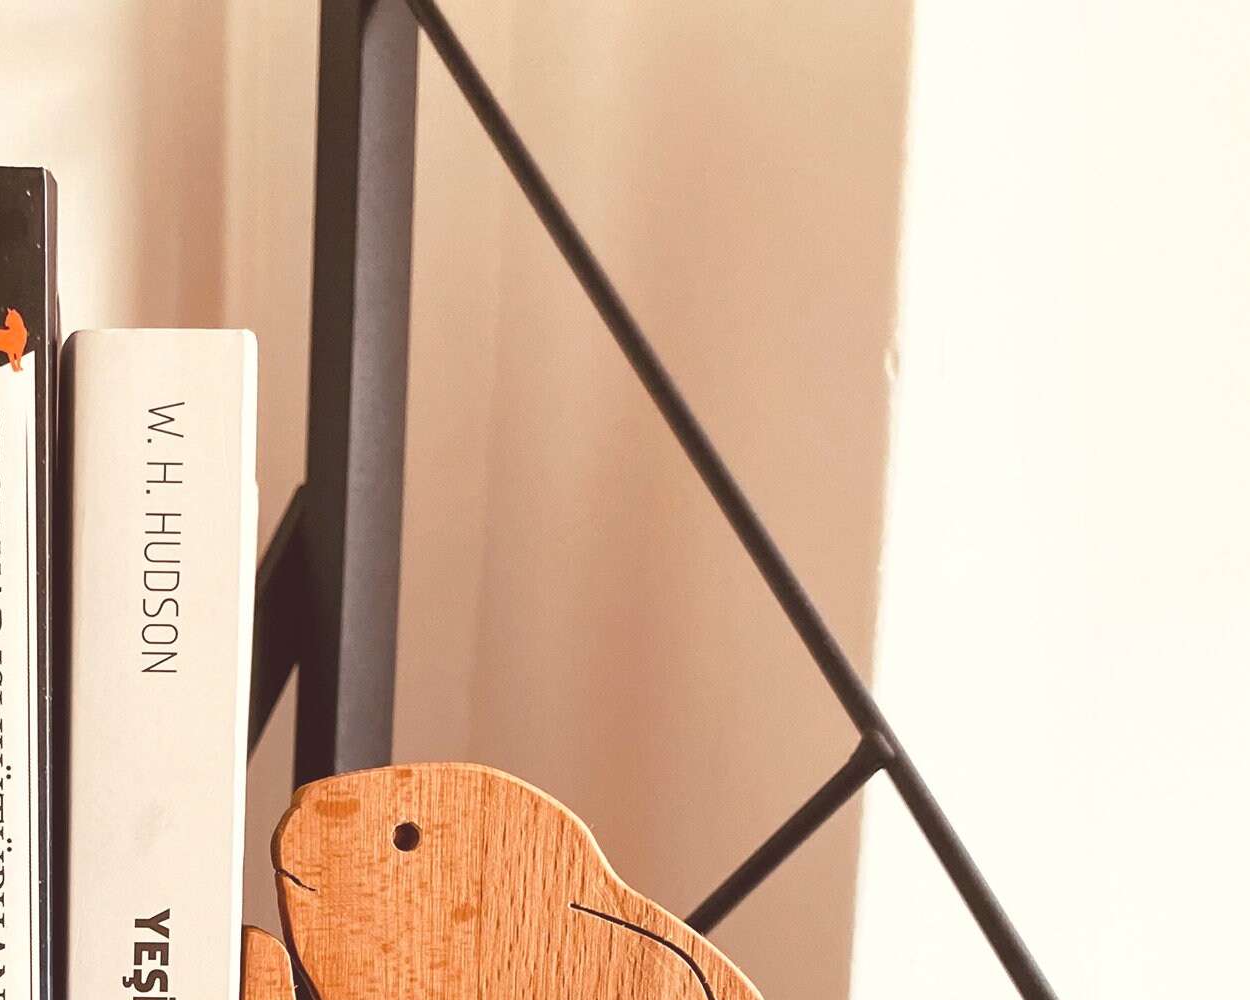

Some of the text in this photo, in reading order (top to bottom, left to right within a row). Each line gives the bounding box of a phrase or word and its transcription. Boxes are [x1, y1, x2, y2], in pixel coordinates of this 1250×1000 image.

[140, 401, 186, 674] W. H. HUDSON
